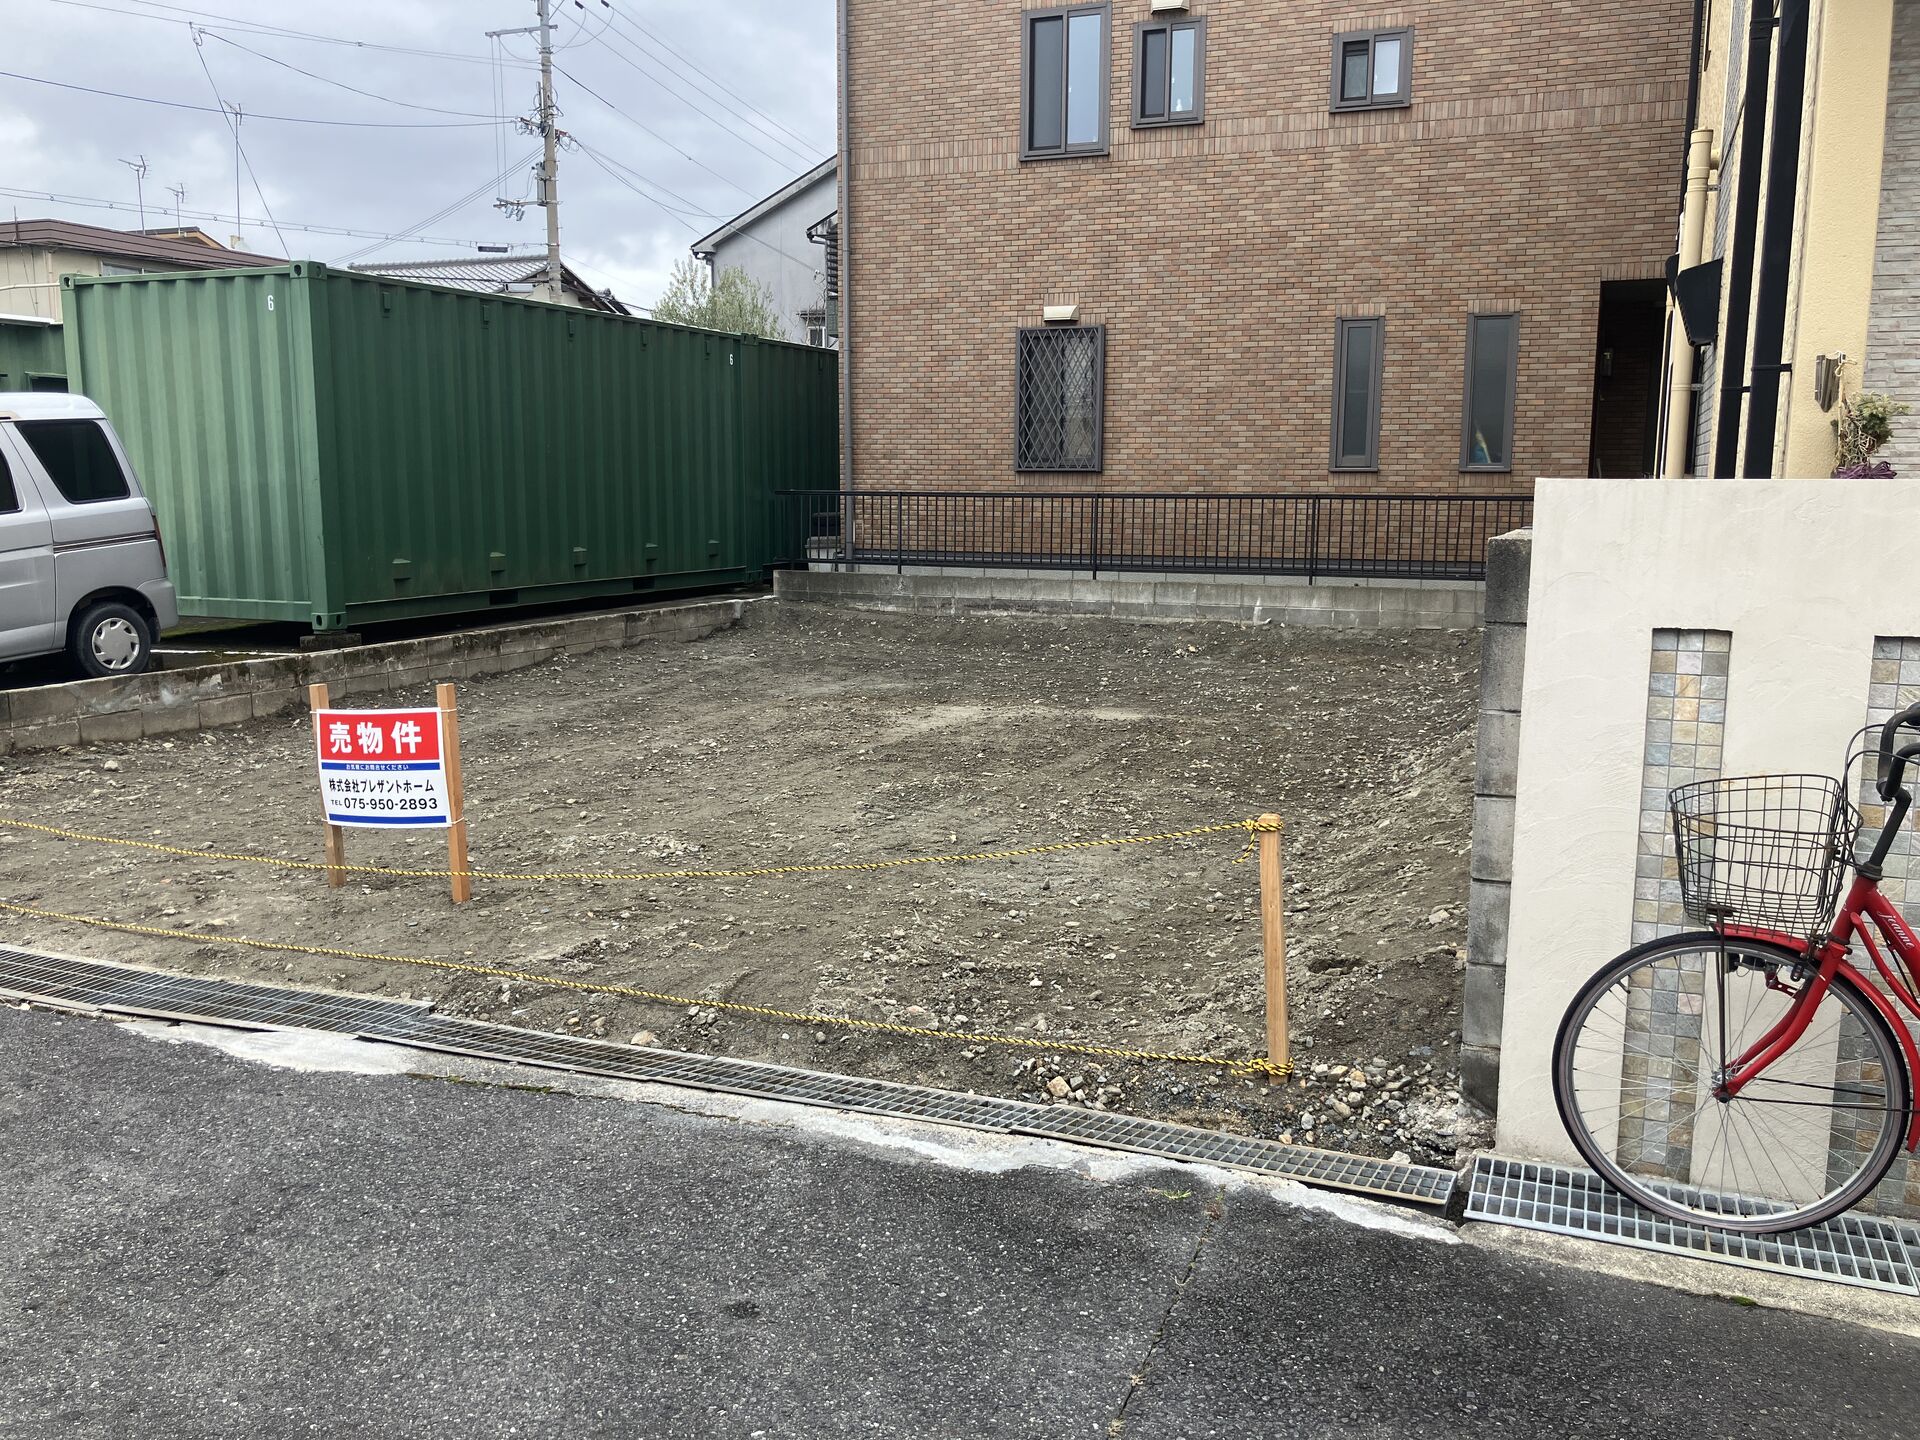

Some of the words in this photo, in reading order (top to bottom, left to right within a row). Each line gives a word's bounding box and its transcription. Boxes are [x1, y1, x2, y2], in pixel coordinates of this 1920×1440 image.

[267, 295, 274, 311] 6
[729, 353, 734, 366] 6
[329, 720, 422, 754] 売物件
[343, 797, 438, 810] 075-950-2893
